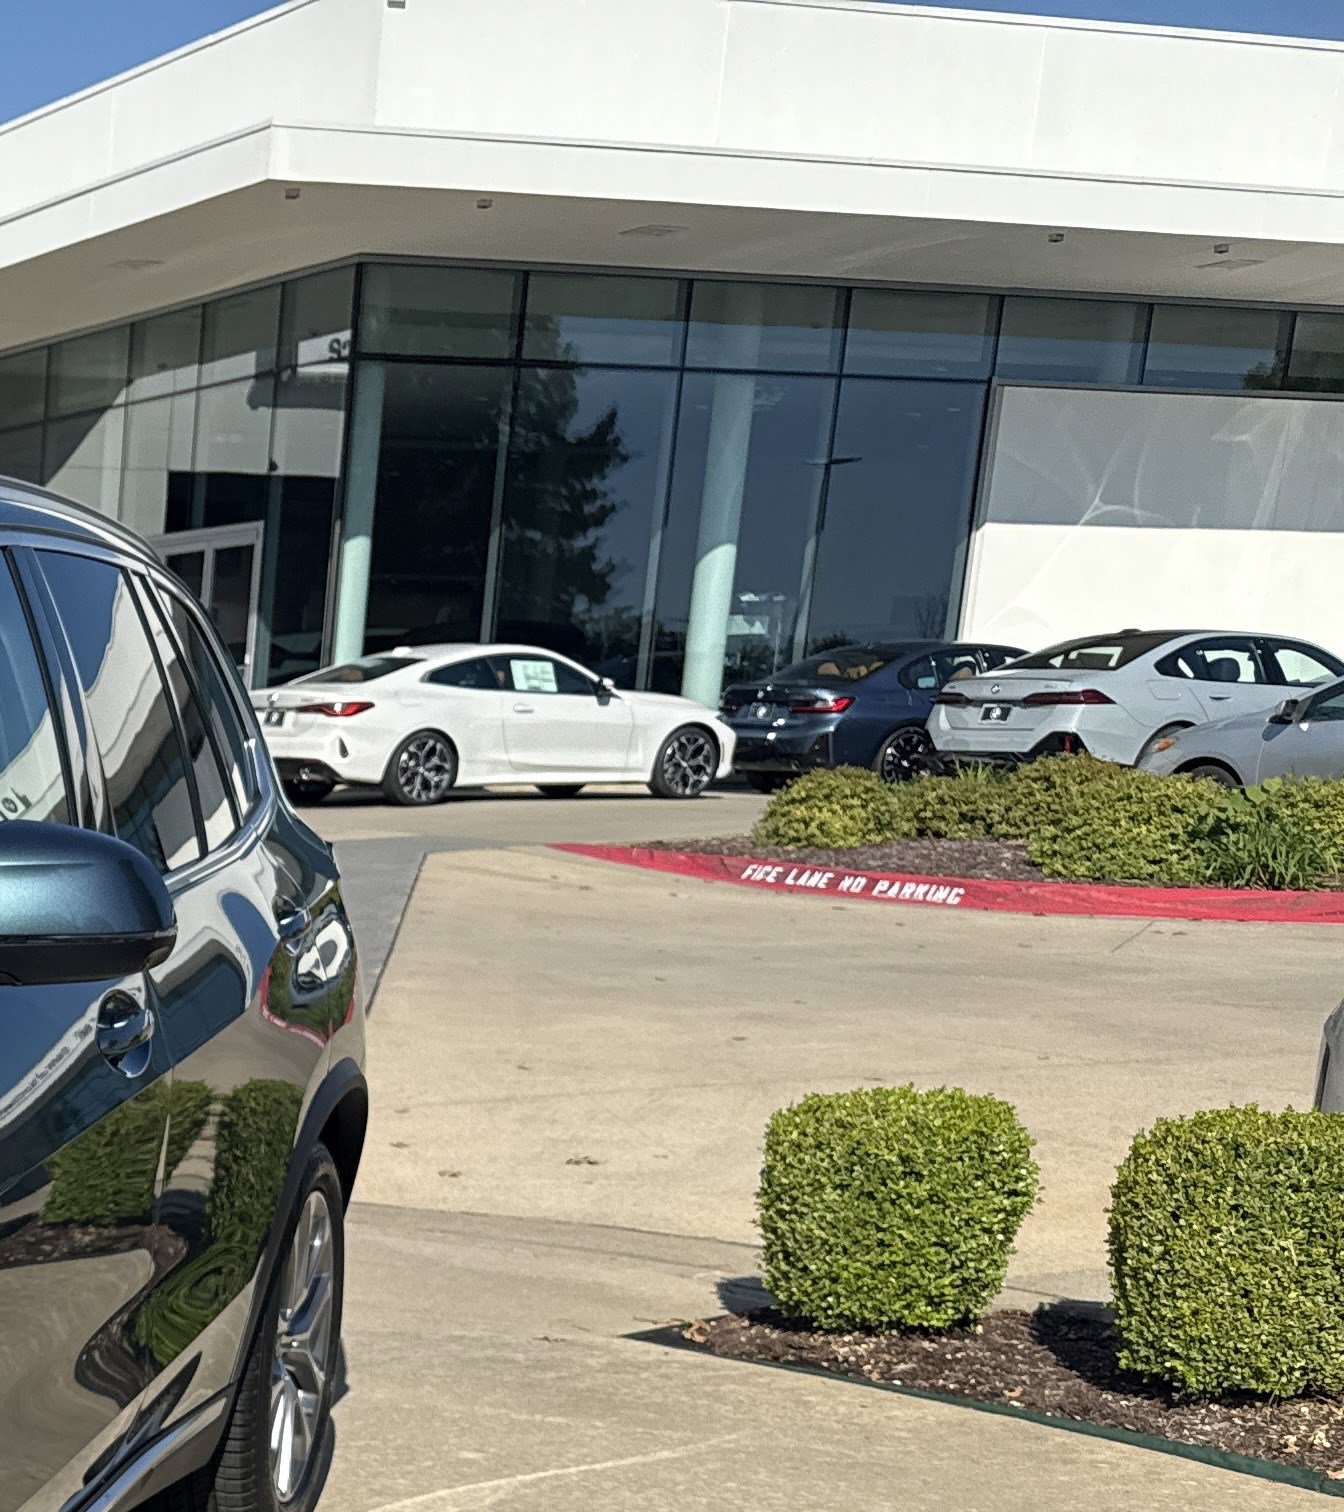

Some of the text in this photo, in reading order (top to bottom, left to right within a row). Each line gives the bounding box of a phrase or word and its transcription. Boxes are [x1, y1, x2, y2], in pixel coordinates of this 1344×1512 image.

[784, 867, 835, 889] LANE
[837, 875, 868, 894] NO
[871, 879, 966, 905] PARKING
